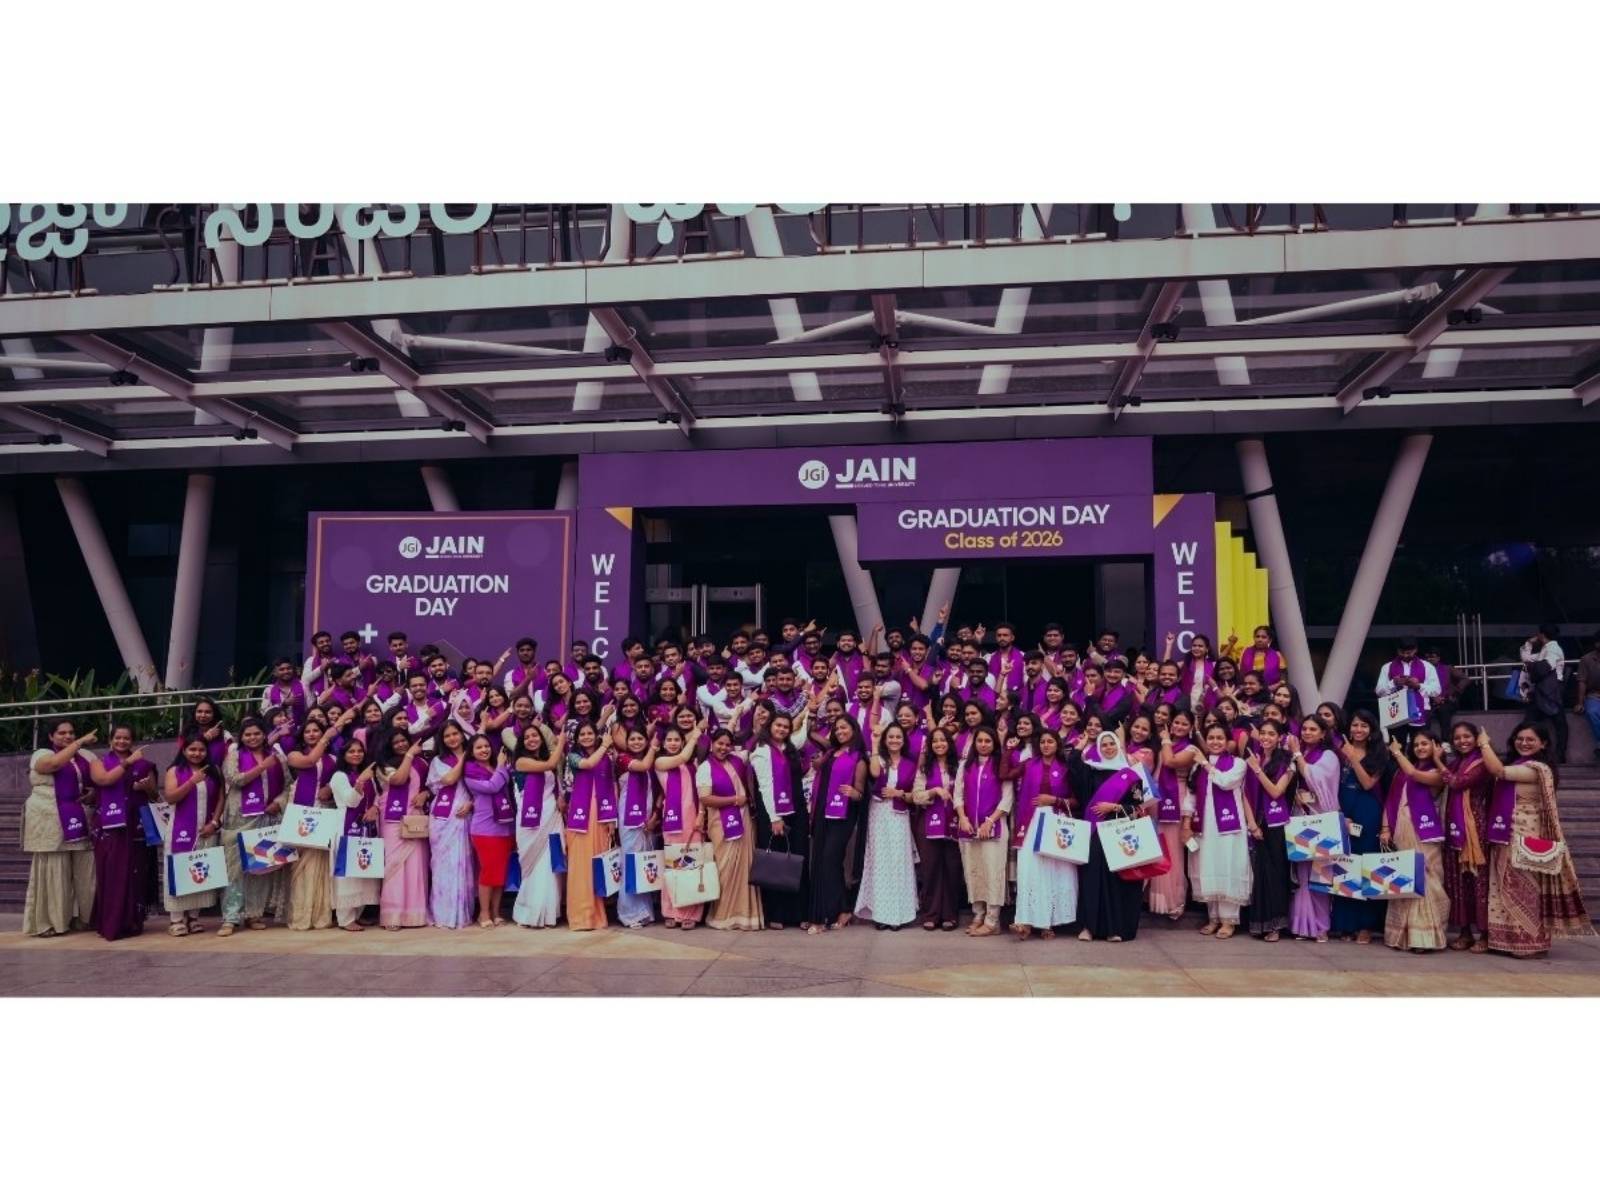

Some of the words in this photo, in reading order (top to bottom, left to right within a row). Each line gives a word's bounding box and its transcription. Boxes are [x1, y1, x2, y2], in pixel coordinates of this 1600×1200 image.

[836, 457, 916, 482] JAIN
[898, 506, 1056, 529] GRADUATION
[1063, 504, 1111, 525] DAY
[426, 536, 485, 554] JAIN
[945, 532, 995, 549] Class
[1000, 531, 1018, 548] of
[1022, 530, 1064, 547] 2026
[366, 574, 509, 594] GRADUATION
[415, 597, 458, 616] DAY
